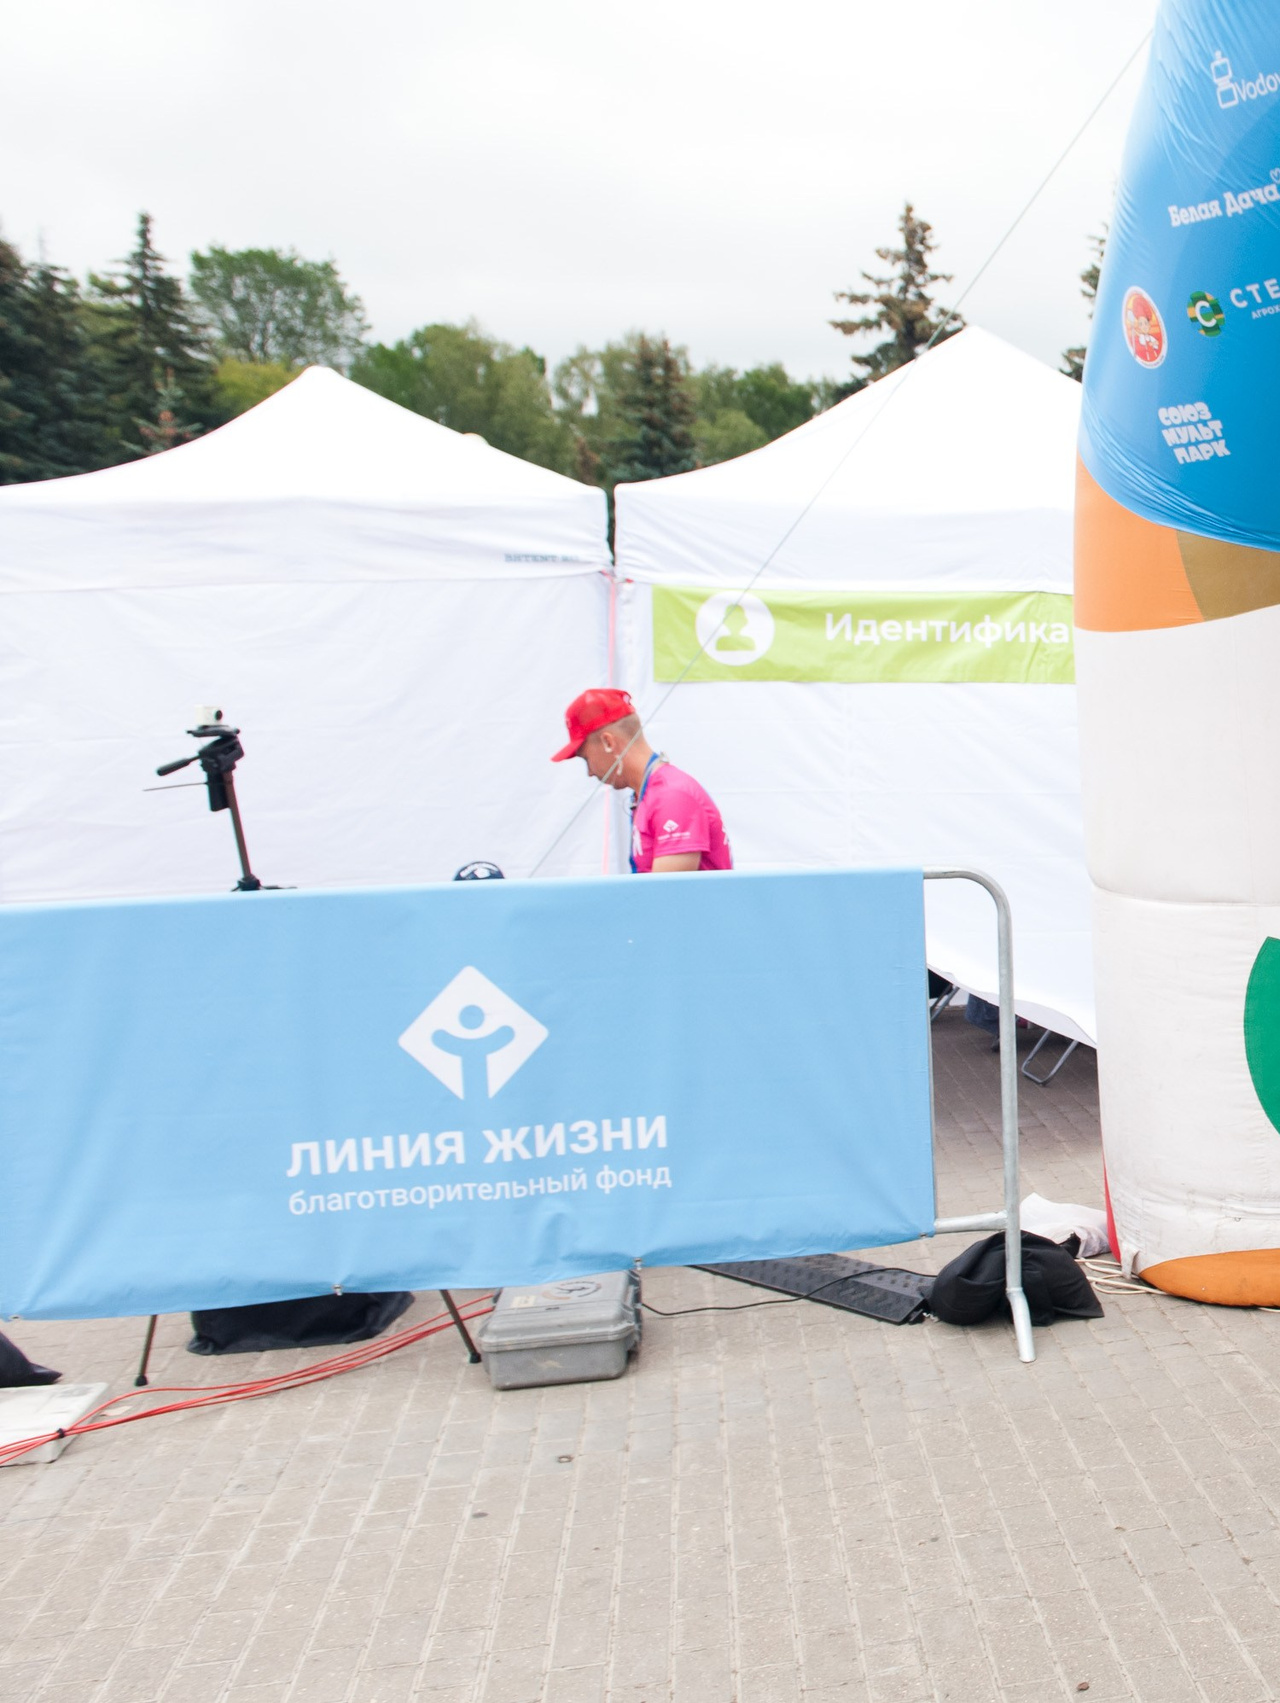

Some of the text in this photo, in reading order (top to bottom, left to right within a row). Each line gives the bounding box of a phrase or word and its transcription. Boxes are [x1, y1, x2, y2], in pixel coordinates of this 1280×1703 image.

[1168, 199, 1222, 227] Белая
[1158, 401, 1212, 426] СОЮЗ
[1161, 419, 1223, 447] МУЛЬТ
[1173, 439, 1231, 465] ПАРК
[825, 612, 1071, 648] Идентифика
[286, 1114, 669, 1178] ЛИНИЯ ЖИЗНИ
[288, 1165, 673, 1216] благотворительный фонд
